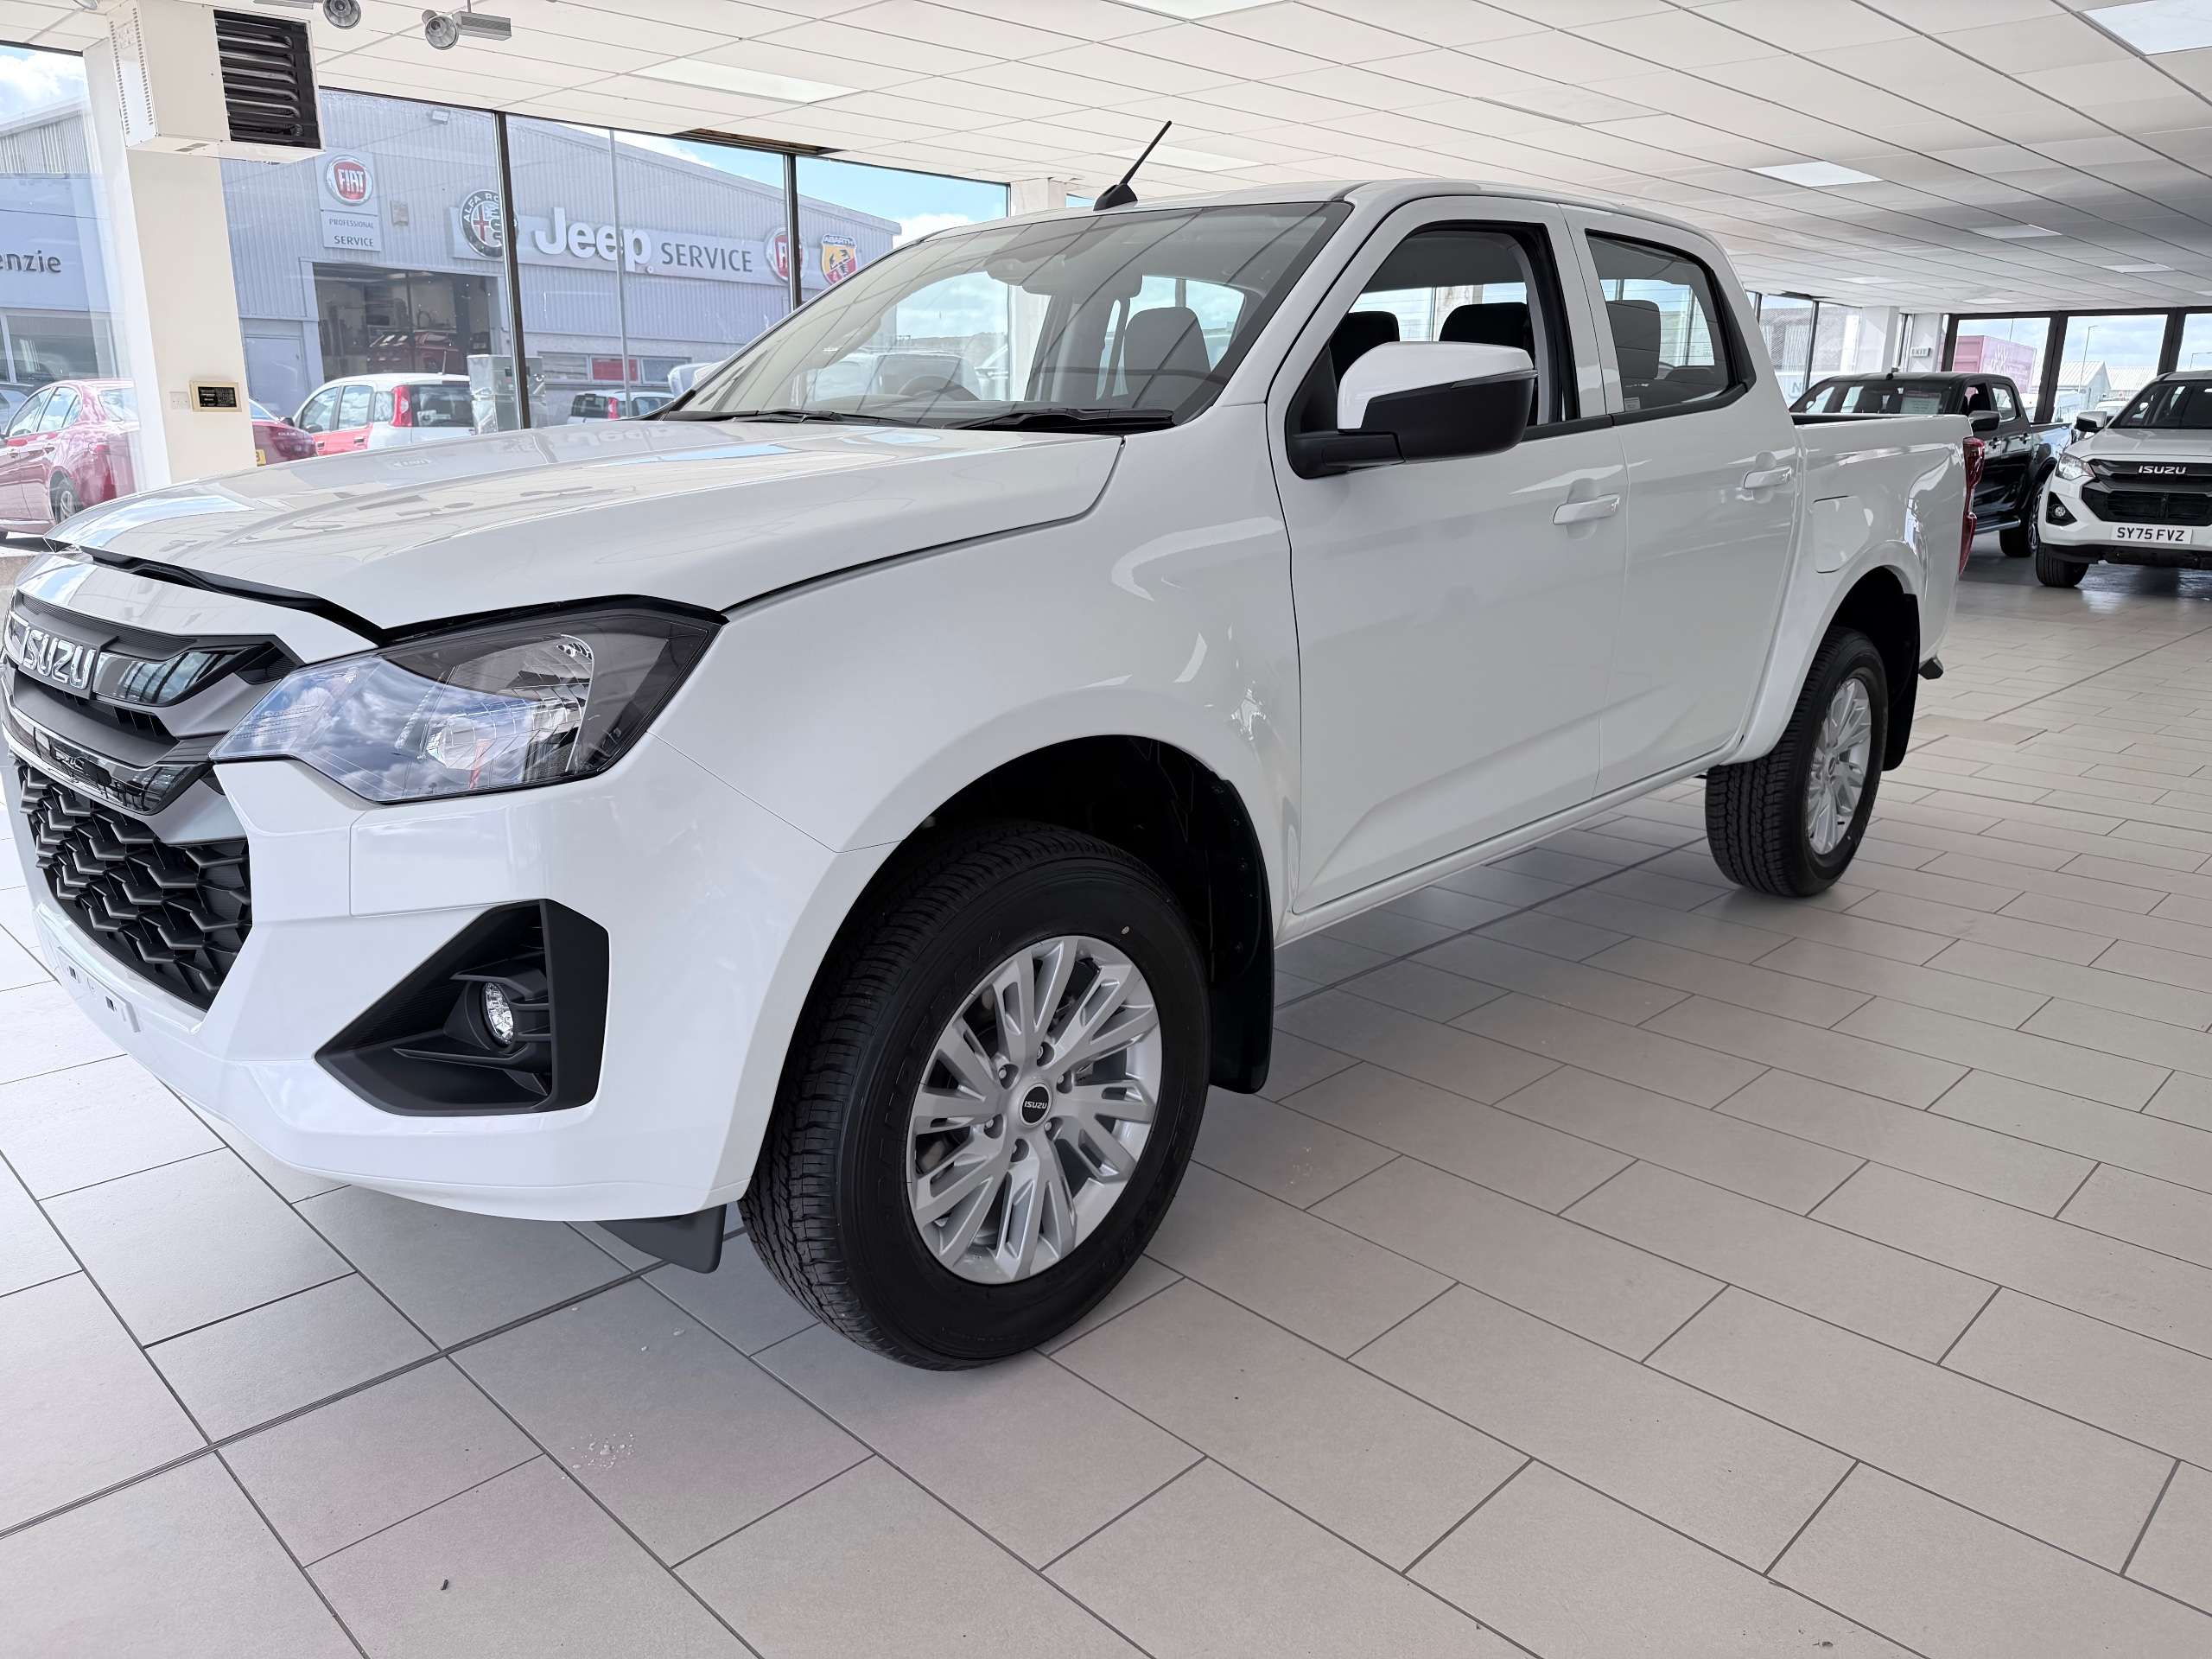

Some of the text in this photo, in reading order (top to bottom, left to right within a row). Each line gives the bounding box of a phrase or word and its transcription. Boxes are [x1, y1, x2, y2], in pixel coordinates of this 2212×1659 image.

[337, 168, 364, 194] FIAT
[463, 195, 481, 223] ALFA
[329, 218, 374, 229] PROFESSIONAL
[334, 235, 374, 247] SERVICE
[534, 207, 753, 273] Jeep SERVICE
[0, 250, 61, 273] nzie
[2138, 465, 2187, 474] ISUZU
[2117, 527, 2185, 542] SY75 FVZ
[19, 626, 97, 690] ISUZU
